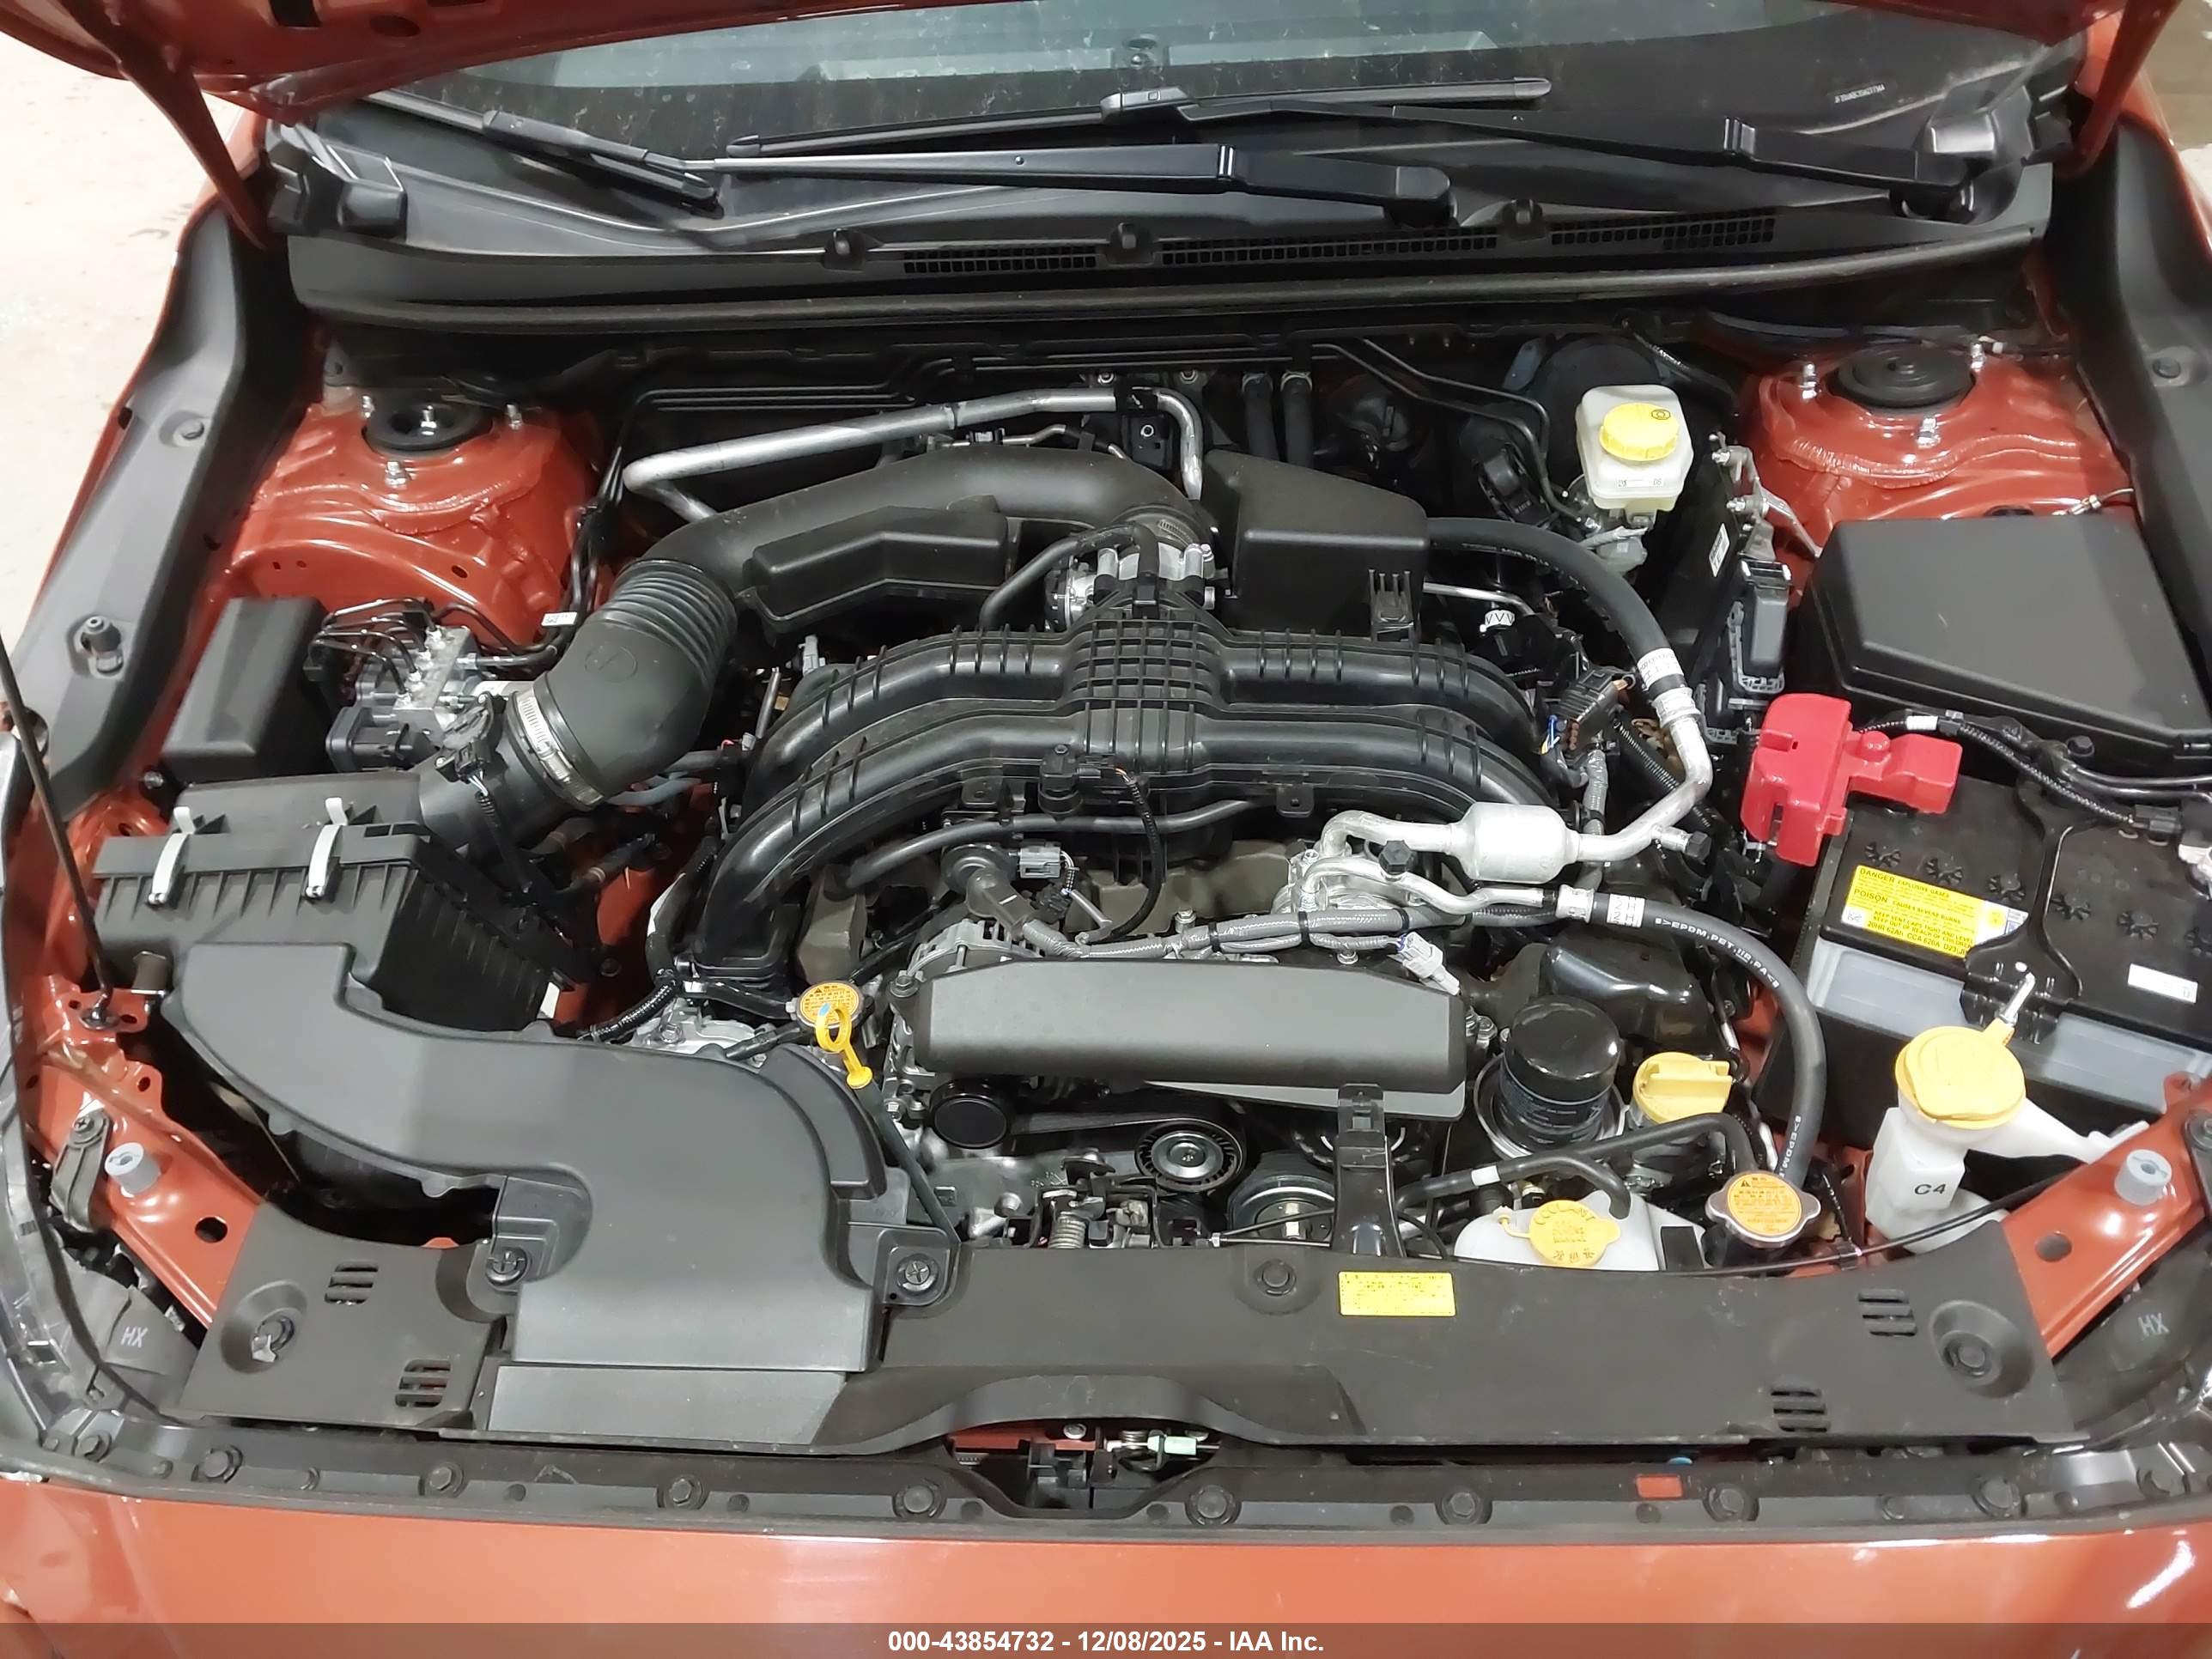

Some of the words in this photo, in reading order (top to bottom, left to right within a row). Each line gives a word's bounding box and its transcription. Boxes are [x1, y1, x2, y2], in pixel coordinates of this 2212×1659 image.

[1859, 867, 1896, 884] DANGER
[1853, 888, 1888, 903] POISON
[1906, 932, 1923, 942] CCA
[1923, 937, 1941, 948] 620A
[1914, 1183, 1947, 1194] C4
[2137, 1312, 2170, 1337] HX
[120, 1326, 149, 1348] HX
